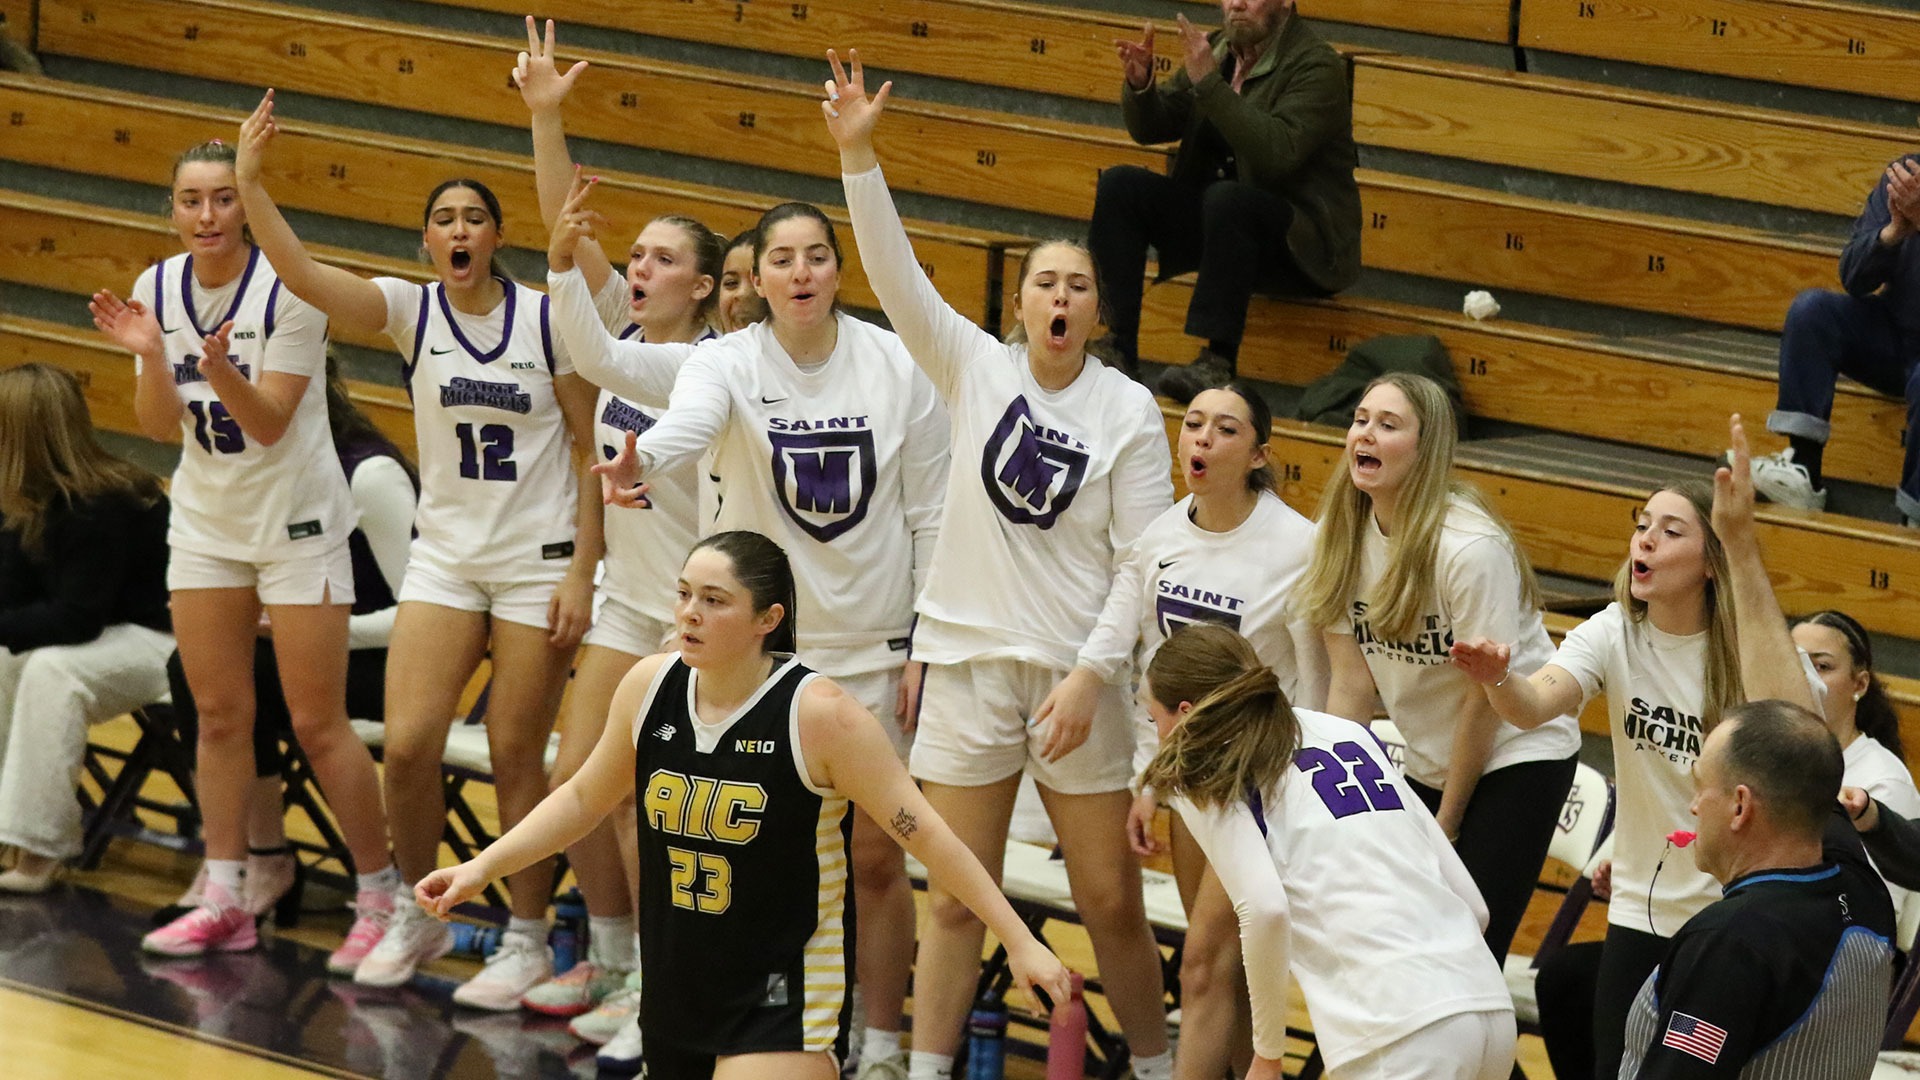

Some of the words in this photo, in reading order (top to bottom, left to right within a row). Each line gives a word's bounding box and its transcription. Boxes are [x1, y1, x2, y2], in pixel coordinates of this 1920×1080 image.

[792, 4, 807, 20] 23
[1578, 2, 1595, 19] 18
[912, 22, 928, 37] 22
[1711, 19, 1727, 36] 17
[1030, 38, 1045, 54] 21
[1847, 39, 1865, 55] 16
[398, 59, 414, 74] 25
[739, 111, 755, 128] 22
[977, 150, 996, 167] 20
[329, 164, 346, 179] 24
[1372, 213, 1387, 230] 17
[1505, 233, 1524, 251] 16
[1648, 255, 1665, 273] 15
[1469, 358, 1487, 376] 15
[451, 378, 518, 396] SAINT
[440, 385, 532, 415] MICHAELS
[188, 401, 246, 455] 15
[769, 415, 868, 431] SAINT
[456, 423, 517, 481] 12
[788, 451, 855, 514] M
[1870, 569, 1889, 589] 13
[1158, 580, 1244, 610] SAINT
[1631, 697, 1702, 733] SAIN
[1624, 706, 1700, 757] MICHA
[1292, 741, 1405, 819] 22
[644, 768, 768, 845] AIC
[667, 846, 732, 914] 23
